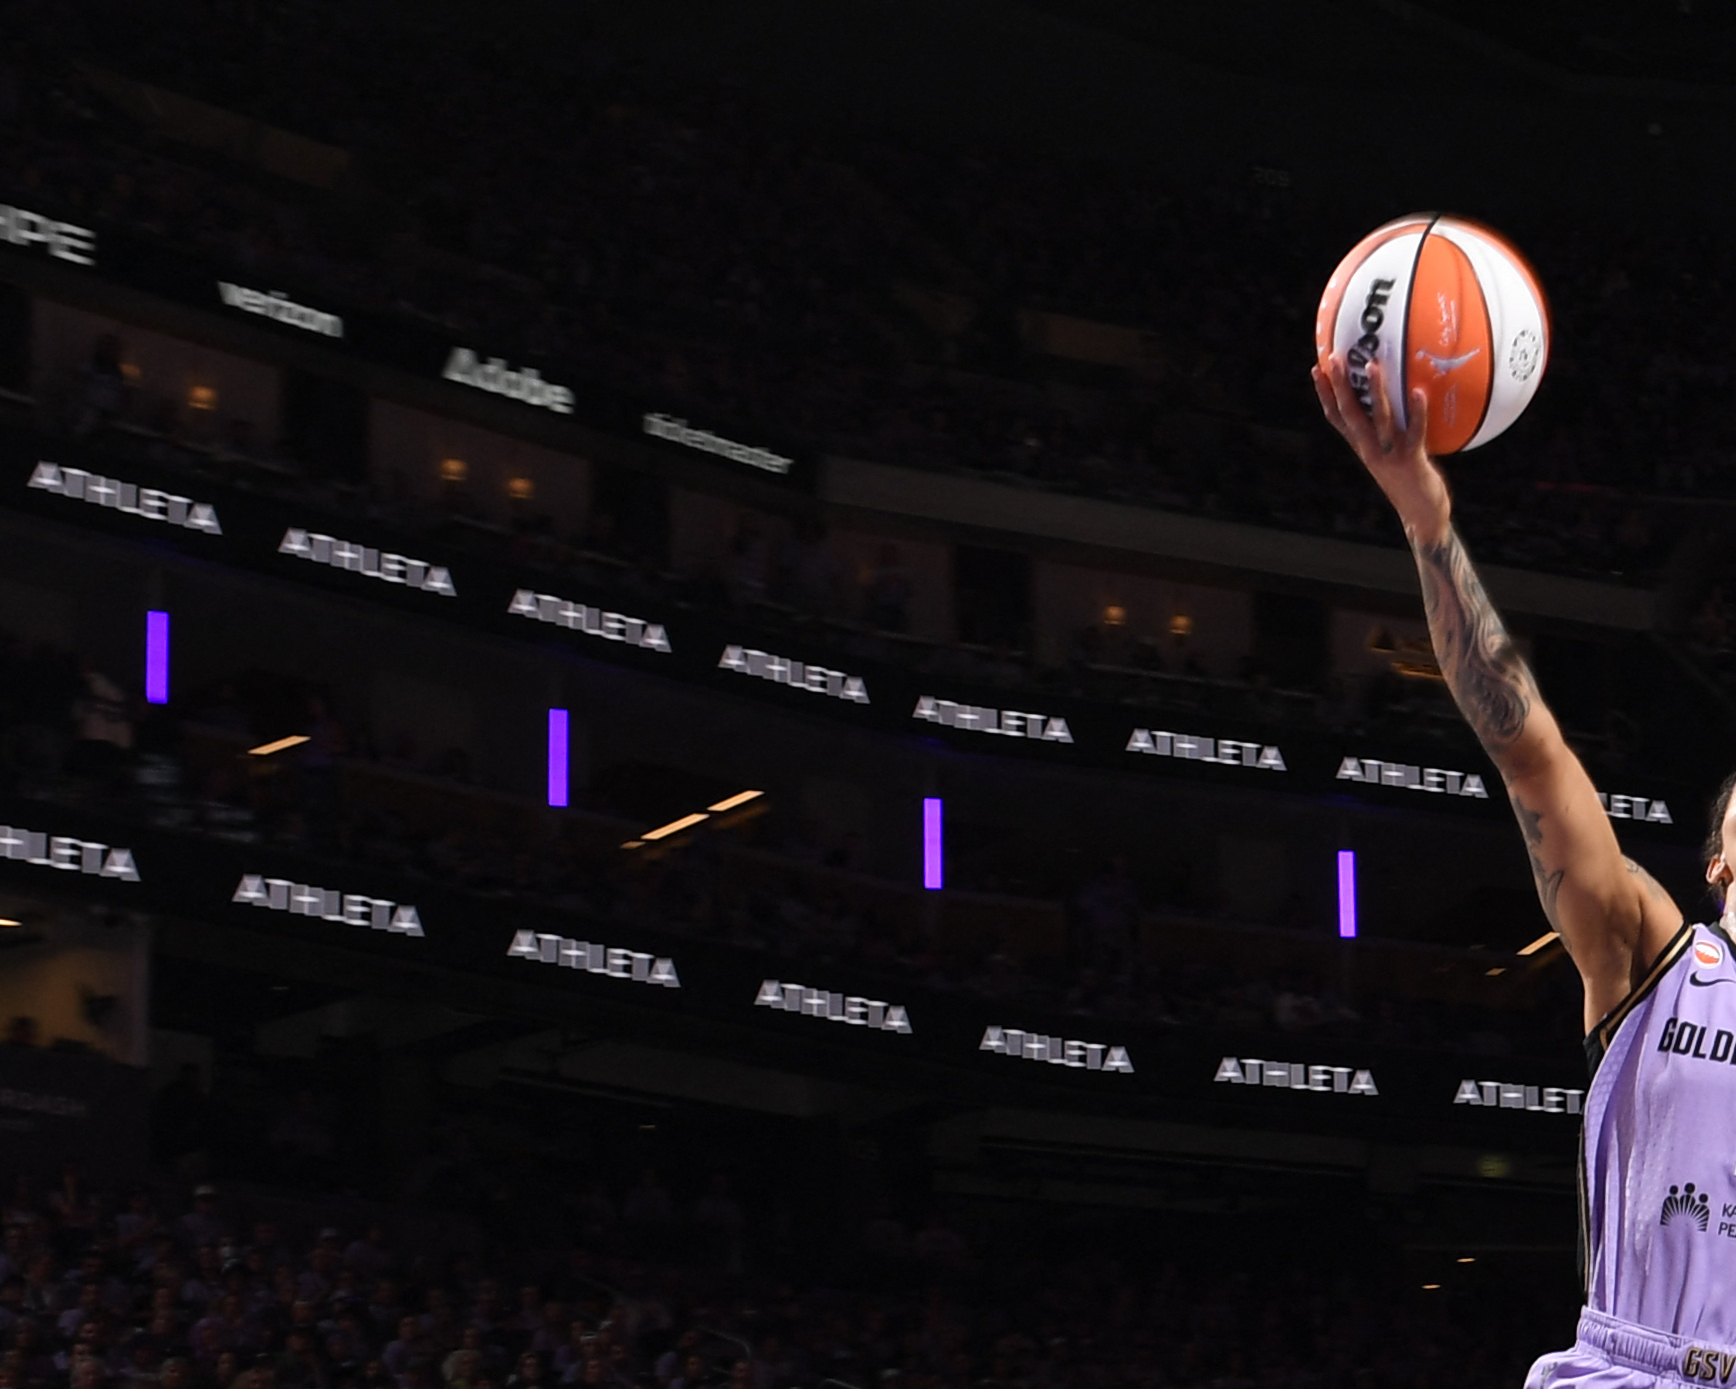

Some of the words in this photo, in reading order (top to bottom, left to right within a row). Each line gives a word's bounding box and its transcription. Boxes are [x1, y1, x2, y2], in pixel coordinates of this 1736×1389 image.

[442, 346, 575, 415] Adobe
[27, 462, 222, 535] ATHLETA
[278, 528, 457, 597] ATHLETA
[507, 589, 672, 653] ATHLETA
[718, 645, 870, 704] ATHLETA
[912, 696, 1074, 744] ATHLETA
[1125, 728, 1287, 771] ATHLETA
[1336, 756, 1488, 799] ATHLETA
[0, 825, 141, 882] HLETA
[232, 873, 425, 938] ATHLETA
[507, 928, 681, 988] ATHLETA
[754, 979, 913, 1034] ATHLETA
[979, 1025, 1135, 1074] ATHLETA
[1213, 1057, 1379, 1097] ATHLETA
[1453, 1078, 1584, 1115] ATHLET
